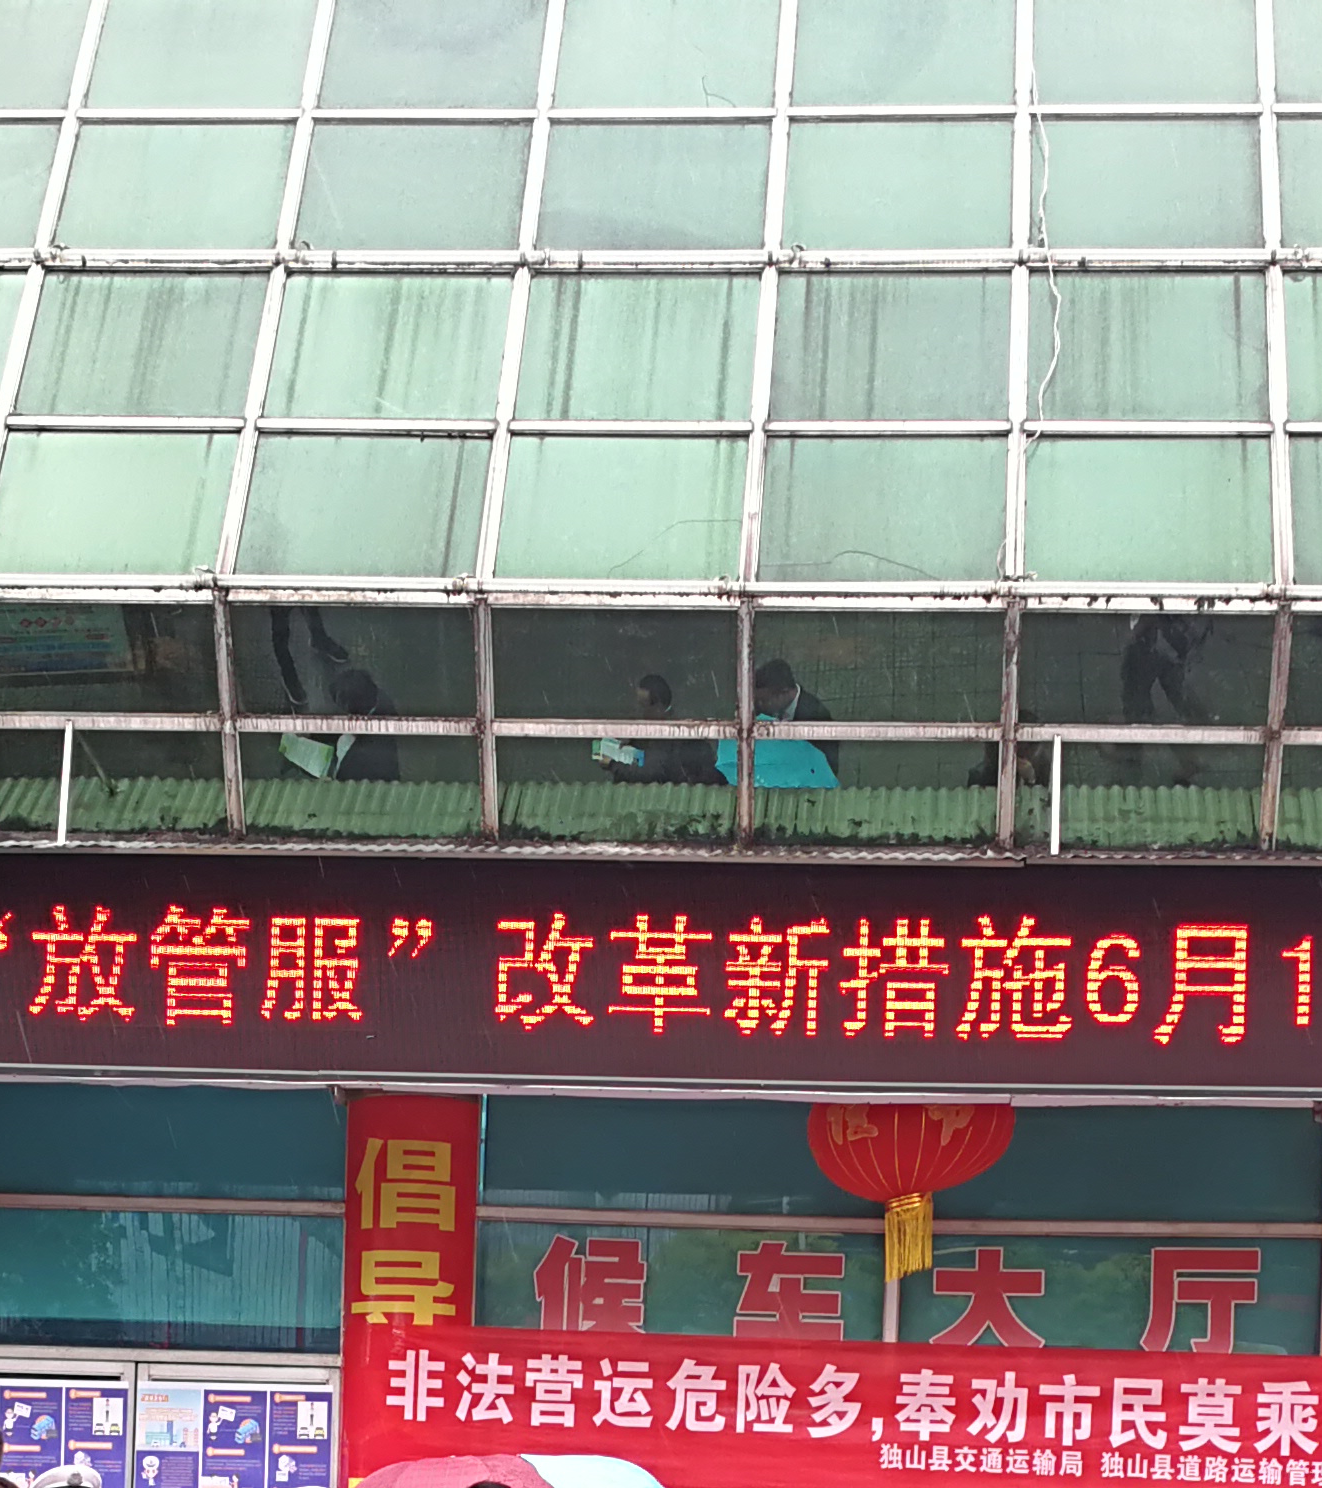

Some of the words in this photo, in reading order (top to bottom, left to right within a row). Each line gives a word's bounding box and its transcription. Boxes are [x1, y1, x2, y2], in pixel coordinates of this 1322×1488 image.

[880, 1443, 1084, 1479] 独山县交通运输局
